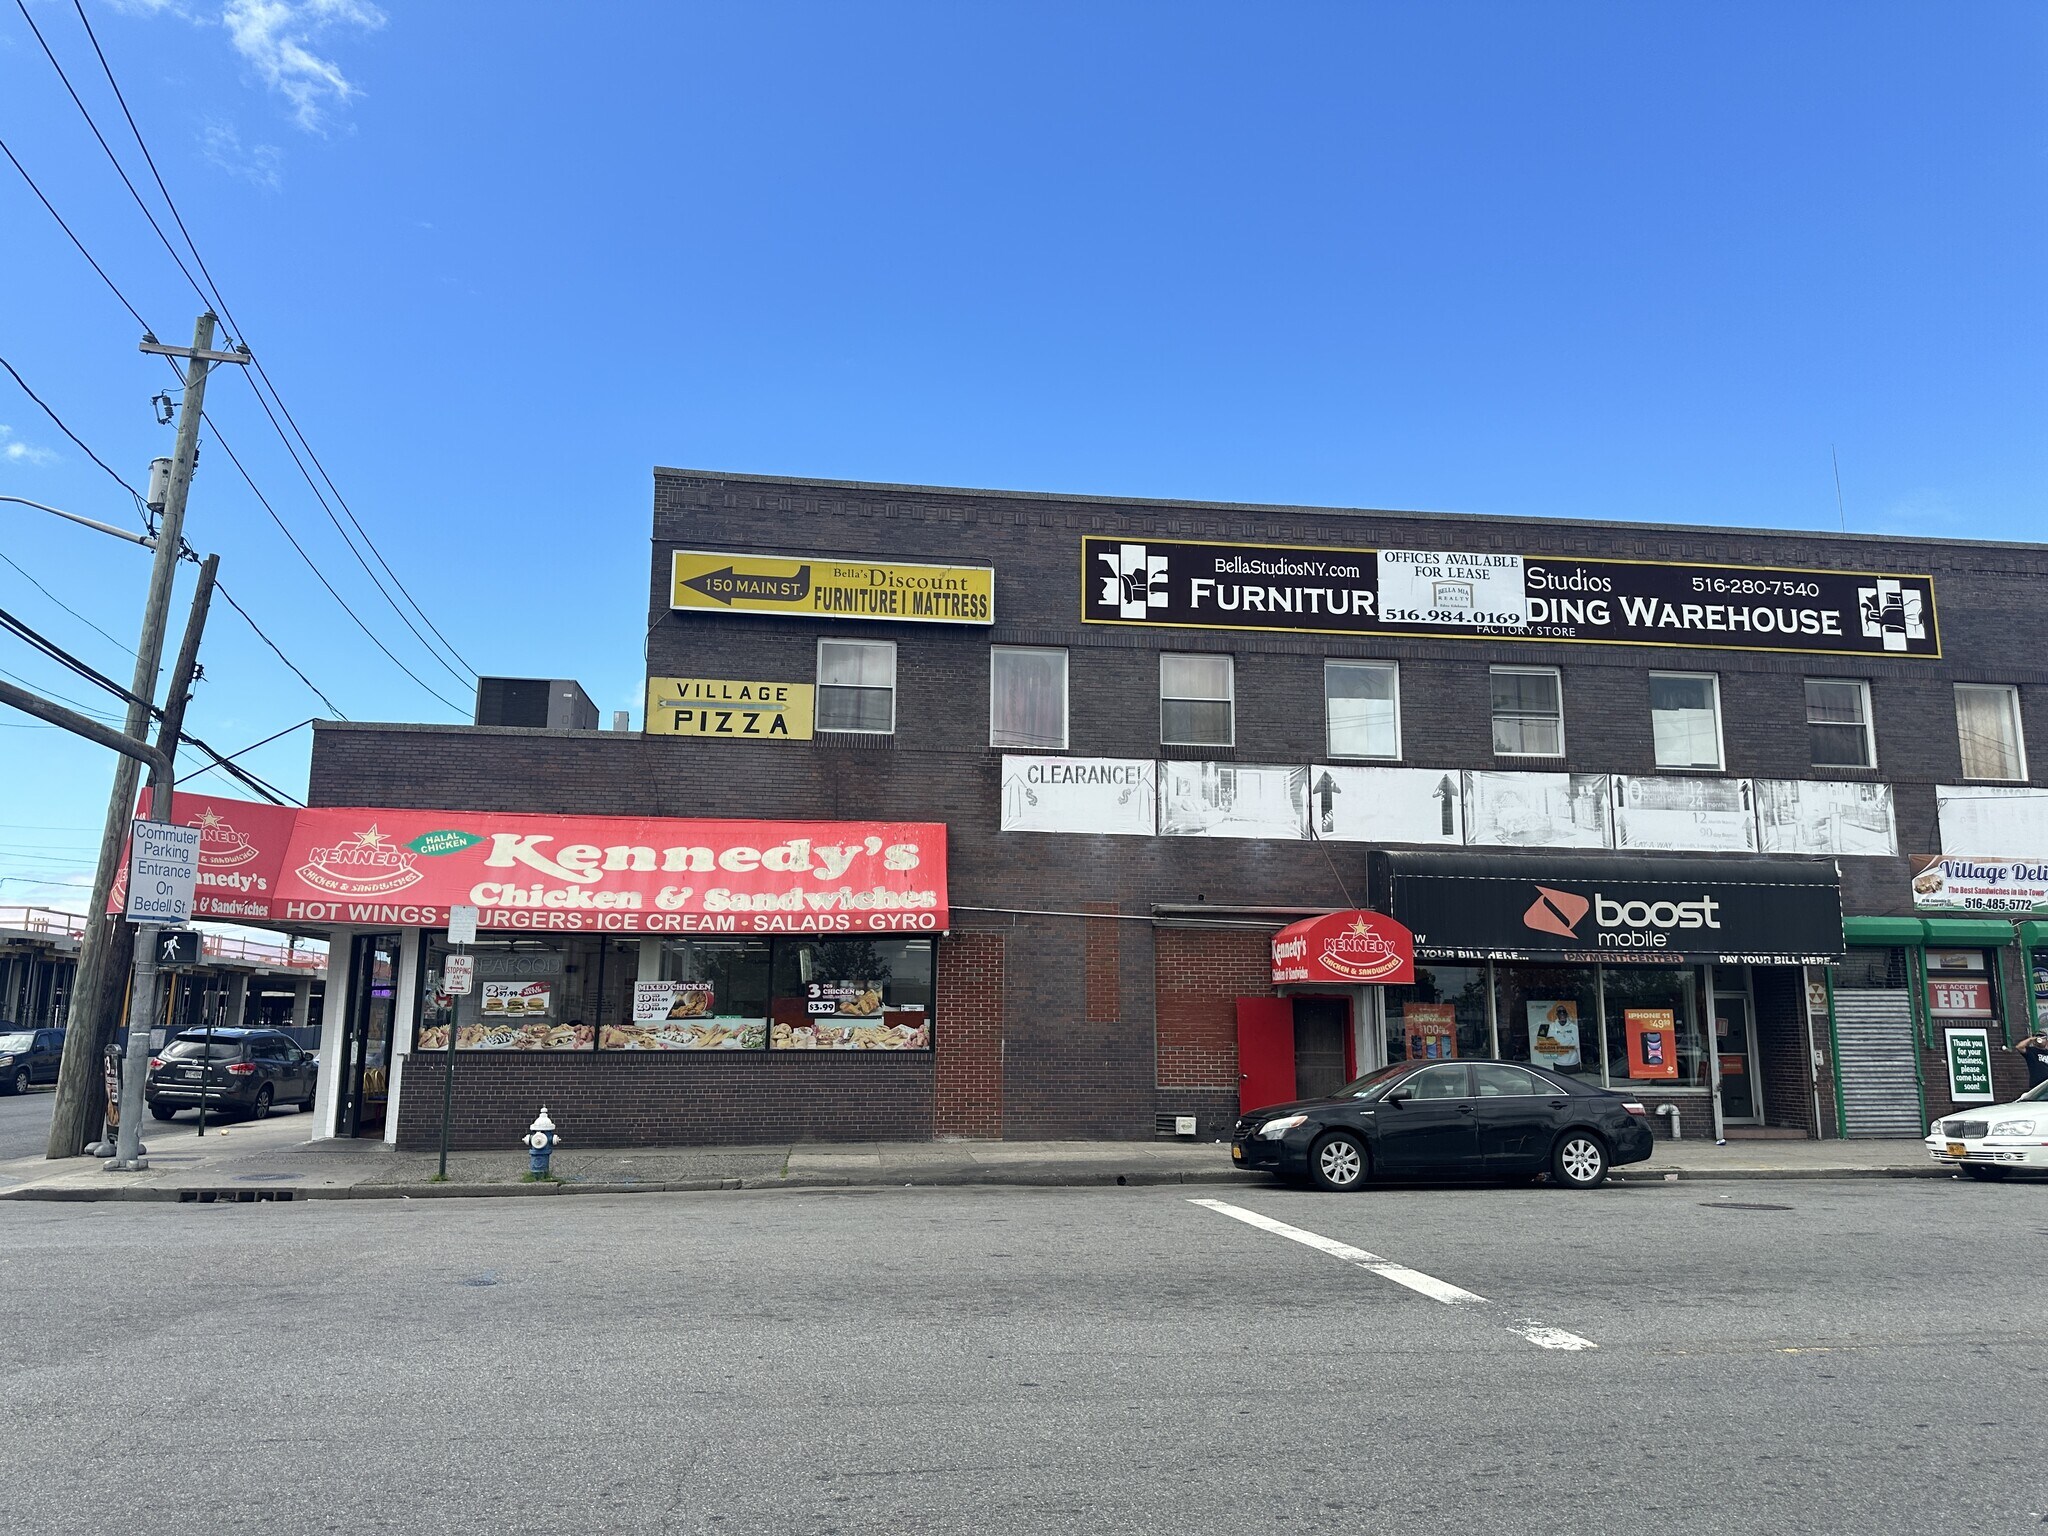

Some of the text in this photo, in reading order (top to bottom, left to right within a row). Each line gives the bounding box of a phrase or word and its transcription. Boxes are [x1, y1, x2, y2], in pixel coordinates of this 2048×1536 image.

[1215, 557, 1360, 578] BellaStudiosNY.com
[1385, 552, 1518, 567] OFFICES AVAILABLE
[834, 567, 968, 591] Bella's Discount
[1415, 566, 1490, 579] FOR LEASE
[1527, 566, 1611, 592] Studios
[705, 578, 803, 596] 150 MAIN ST.
[1438, 587, 1469, 596] BELLA MIA
[1692, 576, 1820, 597] 516-280-7540
[814, 586, 898, 614] FURNITURE
[912, 592, 987, 618] MATTRESS
[1189, 577, 1843, 636] FURNITUR DING WAREHOUSE
[1385, 608, 1520, 624] 516.984.0169
[1477, 626, 1576, 637] FACTORY STORE
[677, 682, 788, 702] VILLAGE
[674, 710, 788, 735] PIZZA
[1027, 764, 1141, 785] CLEARANCE!
[1688, 781, 1703, 794] 12
[1689, 796, 1704, 808] 24
[1692, 812, 1707, 824] 12
[136, 823, 198, 845] Commuter
[200, 829, 250, 844] NEDY
[425, 832, 460, 845] HALAL
[144, 841, 189, 862] Parking
[421, 838, 467, 853] CHICKEN
[308, 847, 418, 867] KENNEDY
[484, 833, 920, 884] Kennedy's
[138, 860, 191, 879] Entrance
[1940, 860, 2048, 884] Village Deli
[156, 881, 174, 896] On
[196, 872, 267, 892] nedy's
[302, 868, 417, 892] CHICKEN & SANDWICHES
[469, 882, 937, 912] Chicken & Sandwiches
[1948, 886, 2045, 897] The Best Sandwiches in the Town
[134, 896, 172, 912] Bedell
[174, 899, 187, 914] St.
[200, 897, 210, 912] &
[211, 897, 269, 916] Sandwiches
[286, 901, 342, 921] HOT
[348, 903, 437, 924] WINGS
[1594, 893, 1721, 929] boost
[1964, 898, 2032, 911] 516-485-5772
[476, 910, 581, 929] URGERS
[598, 912, 735, 931] ICE CREAM
[753, 913, 850, 931] SALADS
[868, 912, 936, 930] GYRO
[1324, 937, 1396, 954] KENNEDY
[1598, 930, 1667, 948] mobile
[1272, 935, 1307, 966] Kennedy's
[1421, 949, 1455, 958] YOUR
[1457, 950, 1484, 959] BILL
[1567, 953, 1681, 963] PAYMENT CENTER
[454, 958, 465, 966] NO
[1322, 956, 1400, 975] CHICKEN & SANDWICHES
[1719, 955, 1738, 964] PAY
[1740, 955, 1771, 964] YOUR
[1774, 956, 1800, 965] BILL
[446, 967, 471, 975] STOPPING
[486, 984, 499, 998] 2
[637, 983, 712, 992] MIXED CHICKEN
[808, 983, 821, 999] 3
[637, 994, 652, 1002] 10
[1937, 990, 1978, 1009] EBT
[636, 1003, 652, 1011] 20
[809, 1003, 834, 1011] $3.99
[1952, 1038, 1984, 1048] Thank you
[1956, 1055, 1984, 1065] business,
[1957, 1047, 1982, 1059] for your
[1955, 1073, 1987, 1082] come back
[1960, 1064, 1980, 1074] please
[1963, 1082, 1980, 1090] soon!
